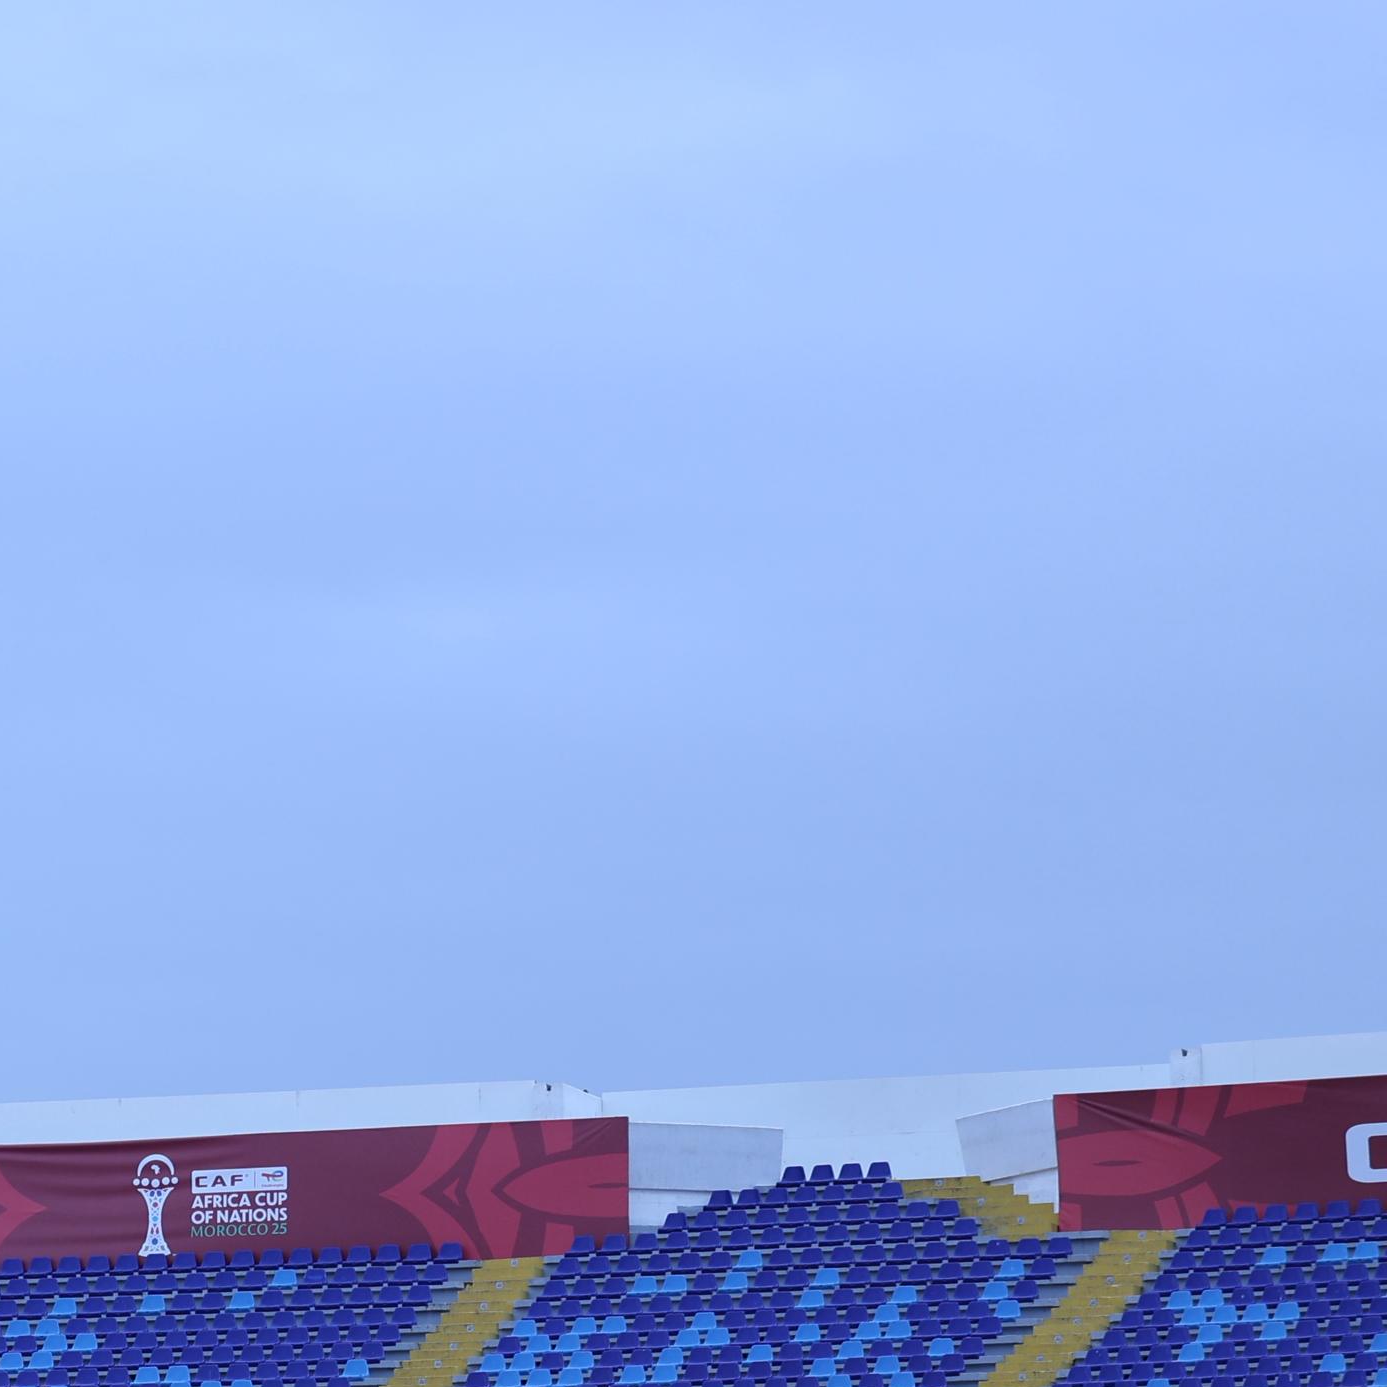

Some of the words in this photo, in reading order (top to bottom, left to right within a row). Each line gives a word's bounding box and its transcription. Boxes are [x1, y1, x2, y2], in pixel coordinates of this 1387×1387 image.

[195, 1175, 243, 1188] CAF
[191, 1193, 251, 1208] AFRICA
[255, 1192, 287, 1206] CUP
[191, 1211, 214, 1224] OF
[216, 1208, 287, 1223] NATIONS
[191, 1223, 268, 1237] MOROCCO
[272, 1222, 287, 1235] 25
